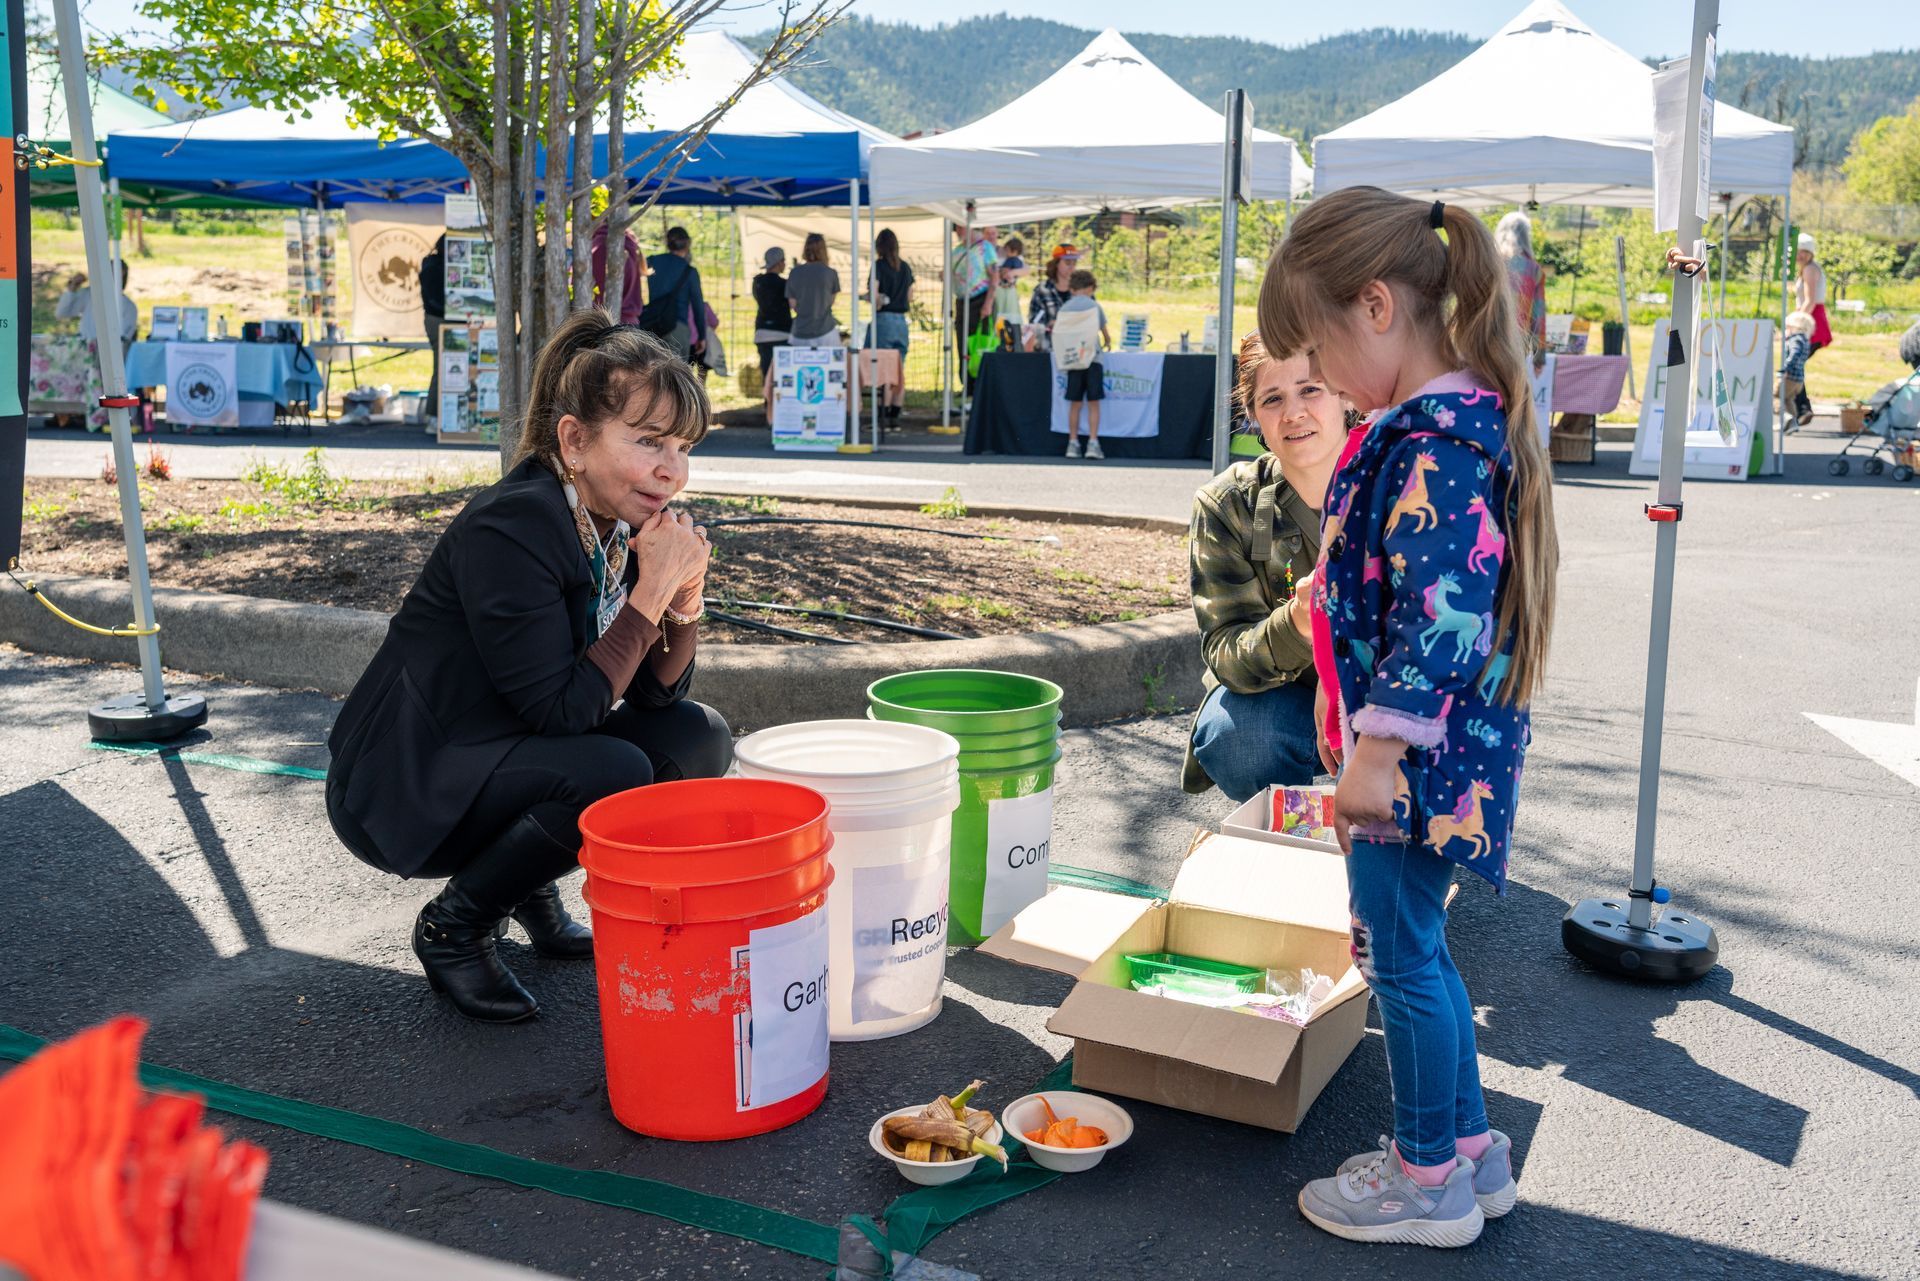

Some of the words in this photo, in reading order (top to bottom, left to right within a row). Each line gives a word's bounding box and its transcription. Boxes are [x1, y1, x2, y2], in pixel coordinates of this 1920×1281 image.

[1664, 322, 1759, 359] OU
[1654, 365, 1756, 403] FM
[1008, 837, 1050, 869] Com
